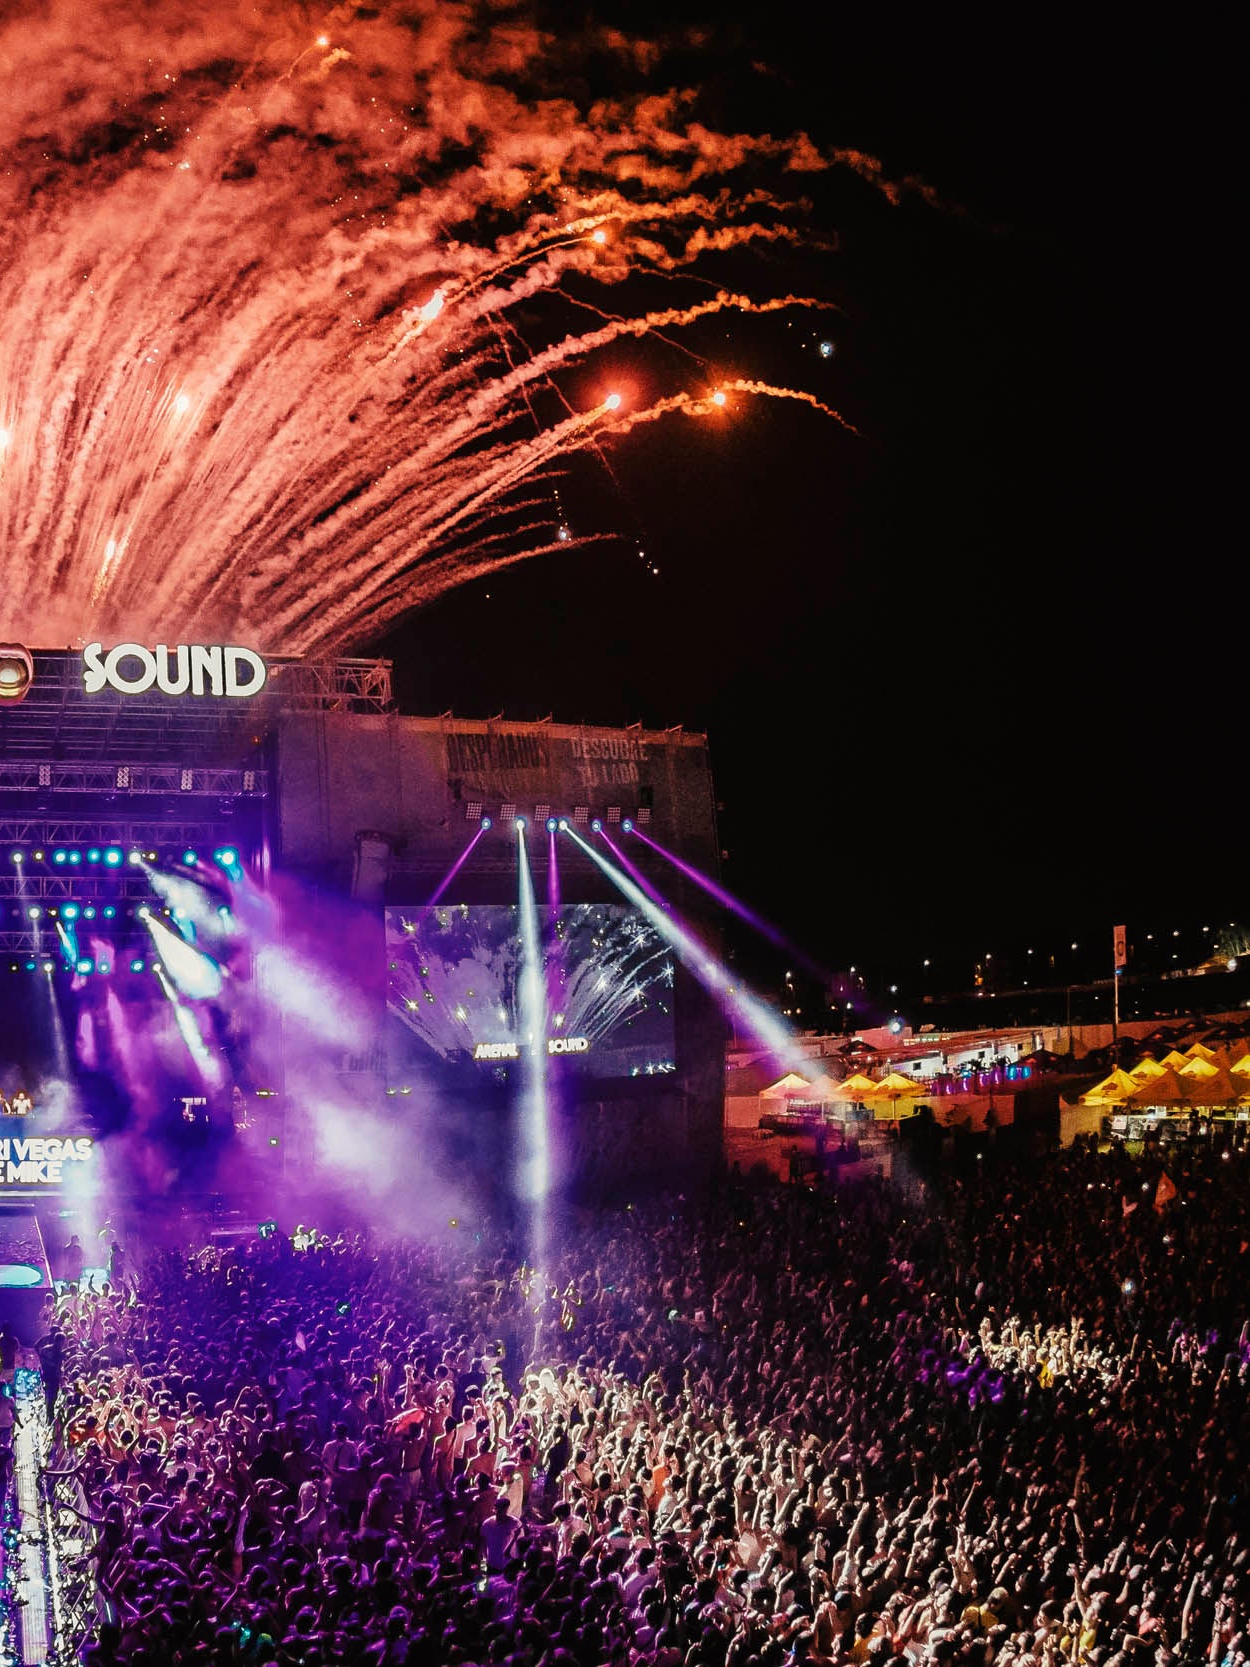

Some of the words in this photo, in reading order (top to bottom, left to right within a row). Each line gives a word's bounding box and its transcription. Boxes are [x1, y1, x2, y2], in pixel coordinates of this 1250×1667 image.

[83, 643, 266, 698] SOUND
[571, 738, 649, 761] DESCUBRE
[548, 1038, 588, 1053] SOUND
[12, 1138, 94, 1161] VEGAS
[6, 1160, 63, 1183] MIKE
